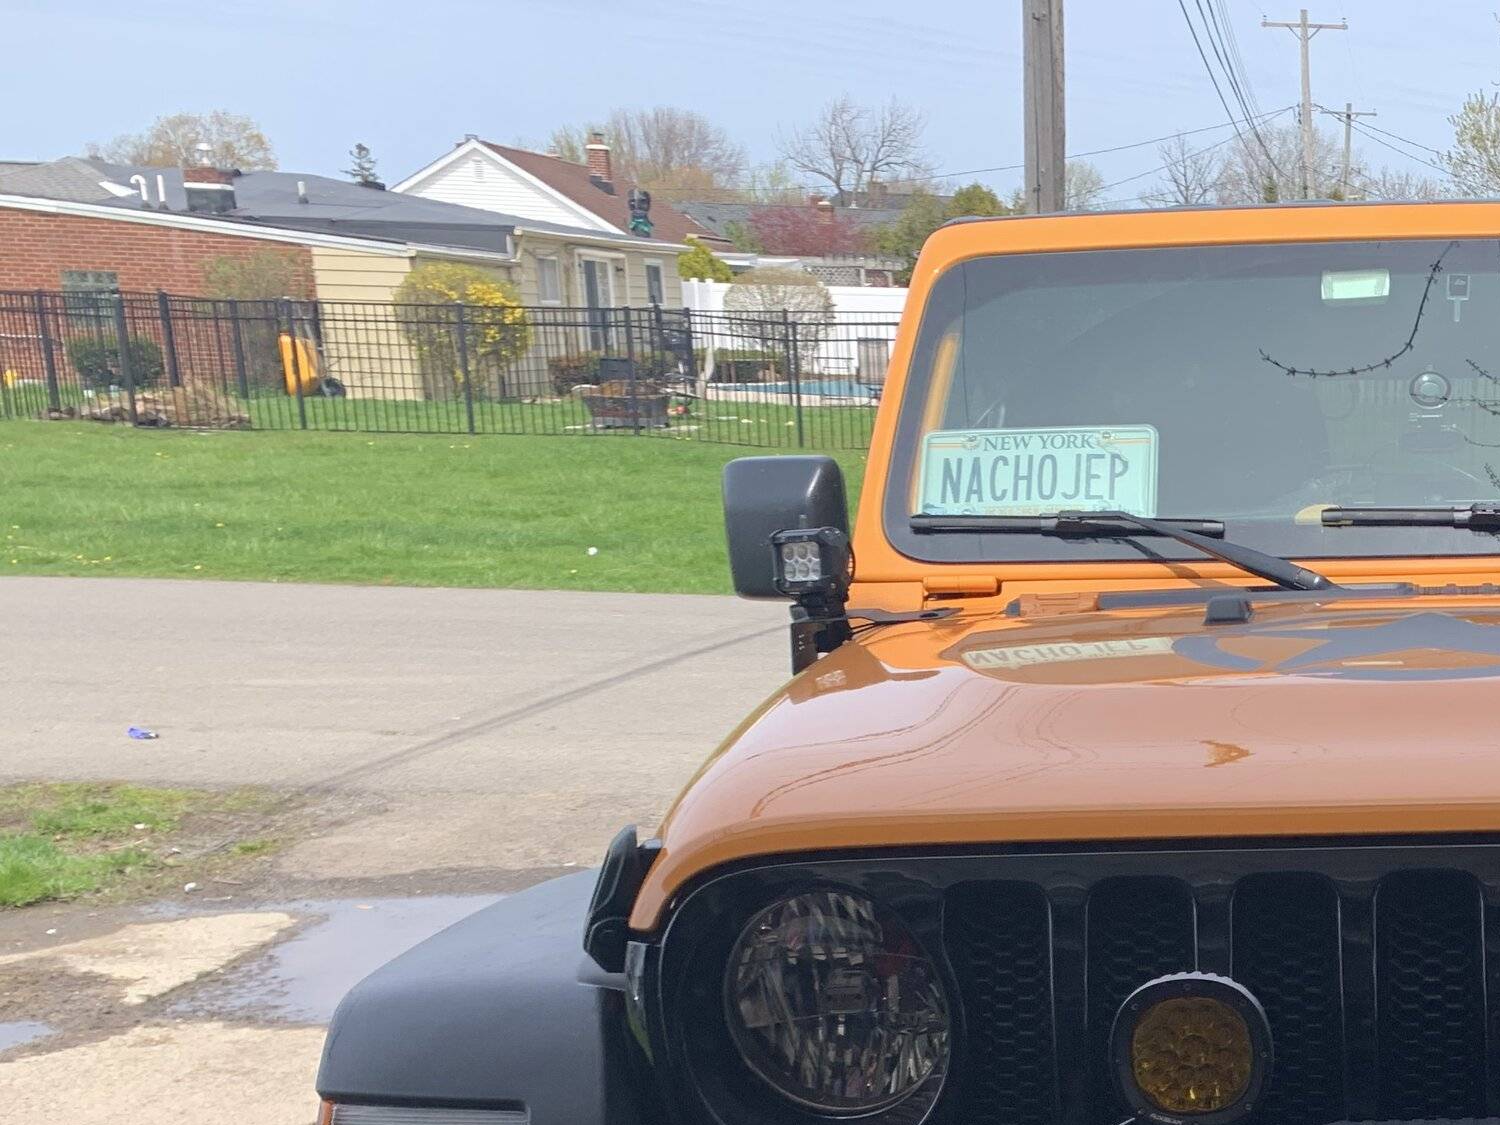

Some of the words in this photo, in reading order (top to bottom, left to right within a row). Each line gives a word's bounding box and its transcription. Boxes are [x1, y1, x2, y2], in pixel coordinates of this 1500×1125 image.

[983, 435, 1033, 451] NEW
[1038, 434, 1095, 449] YORK
[941, 453, 1129, 503] NACHOJEP
